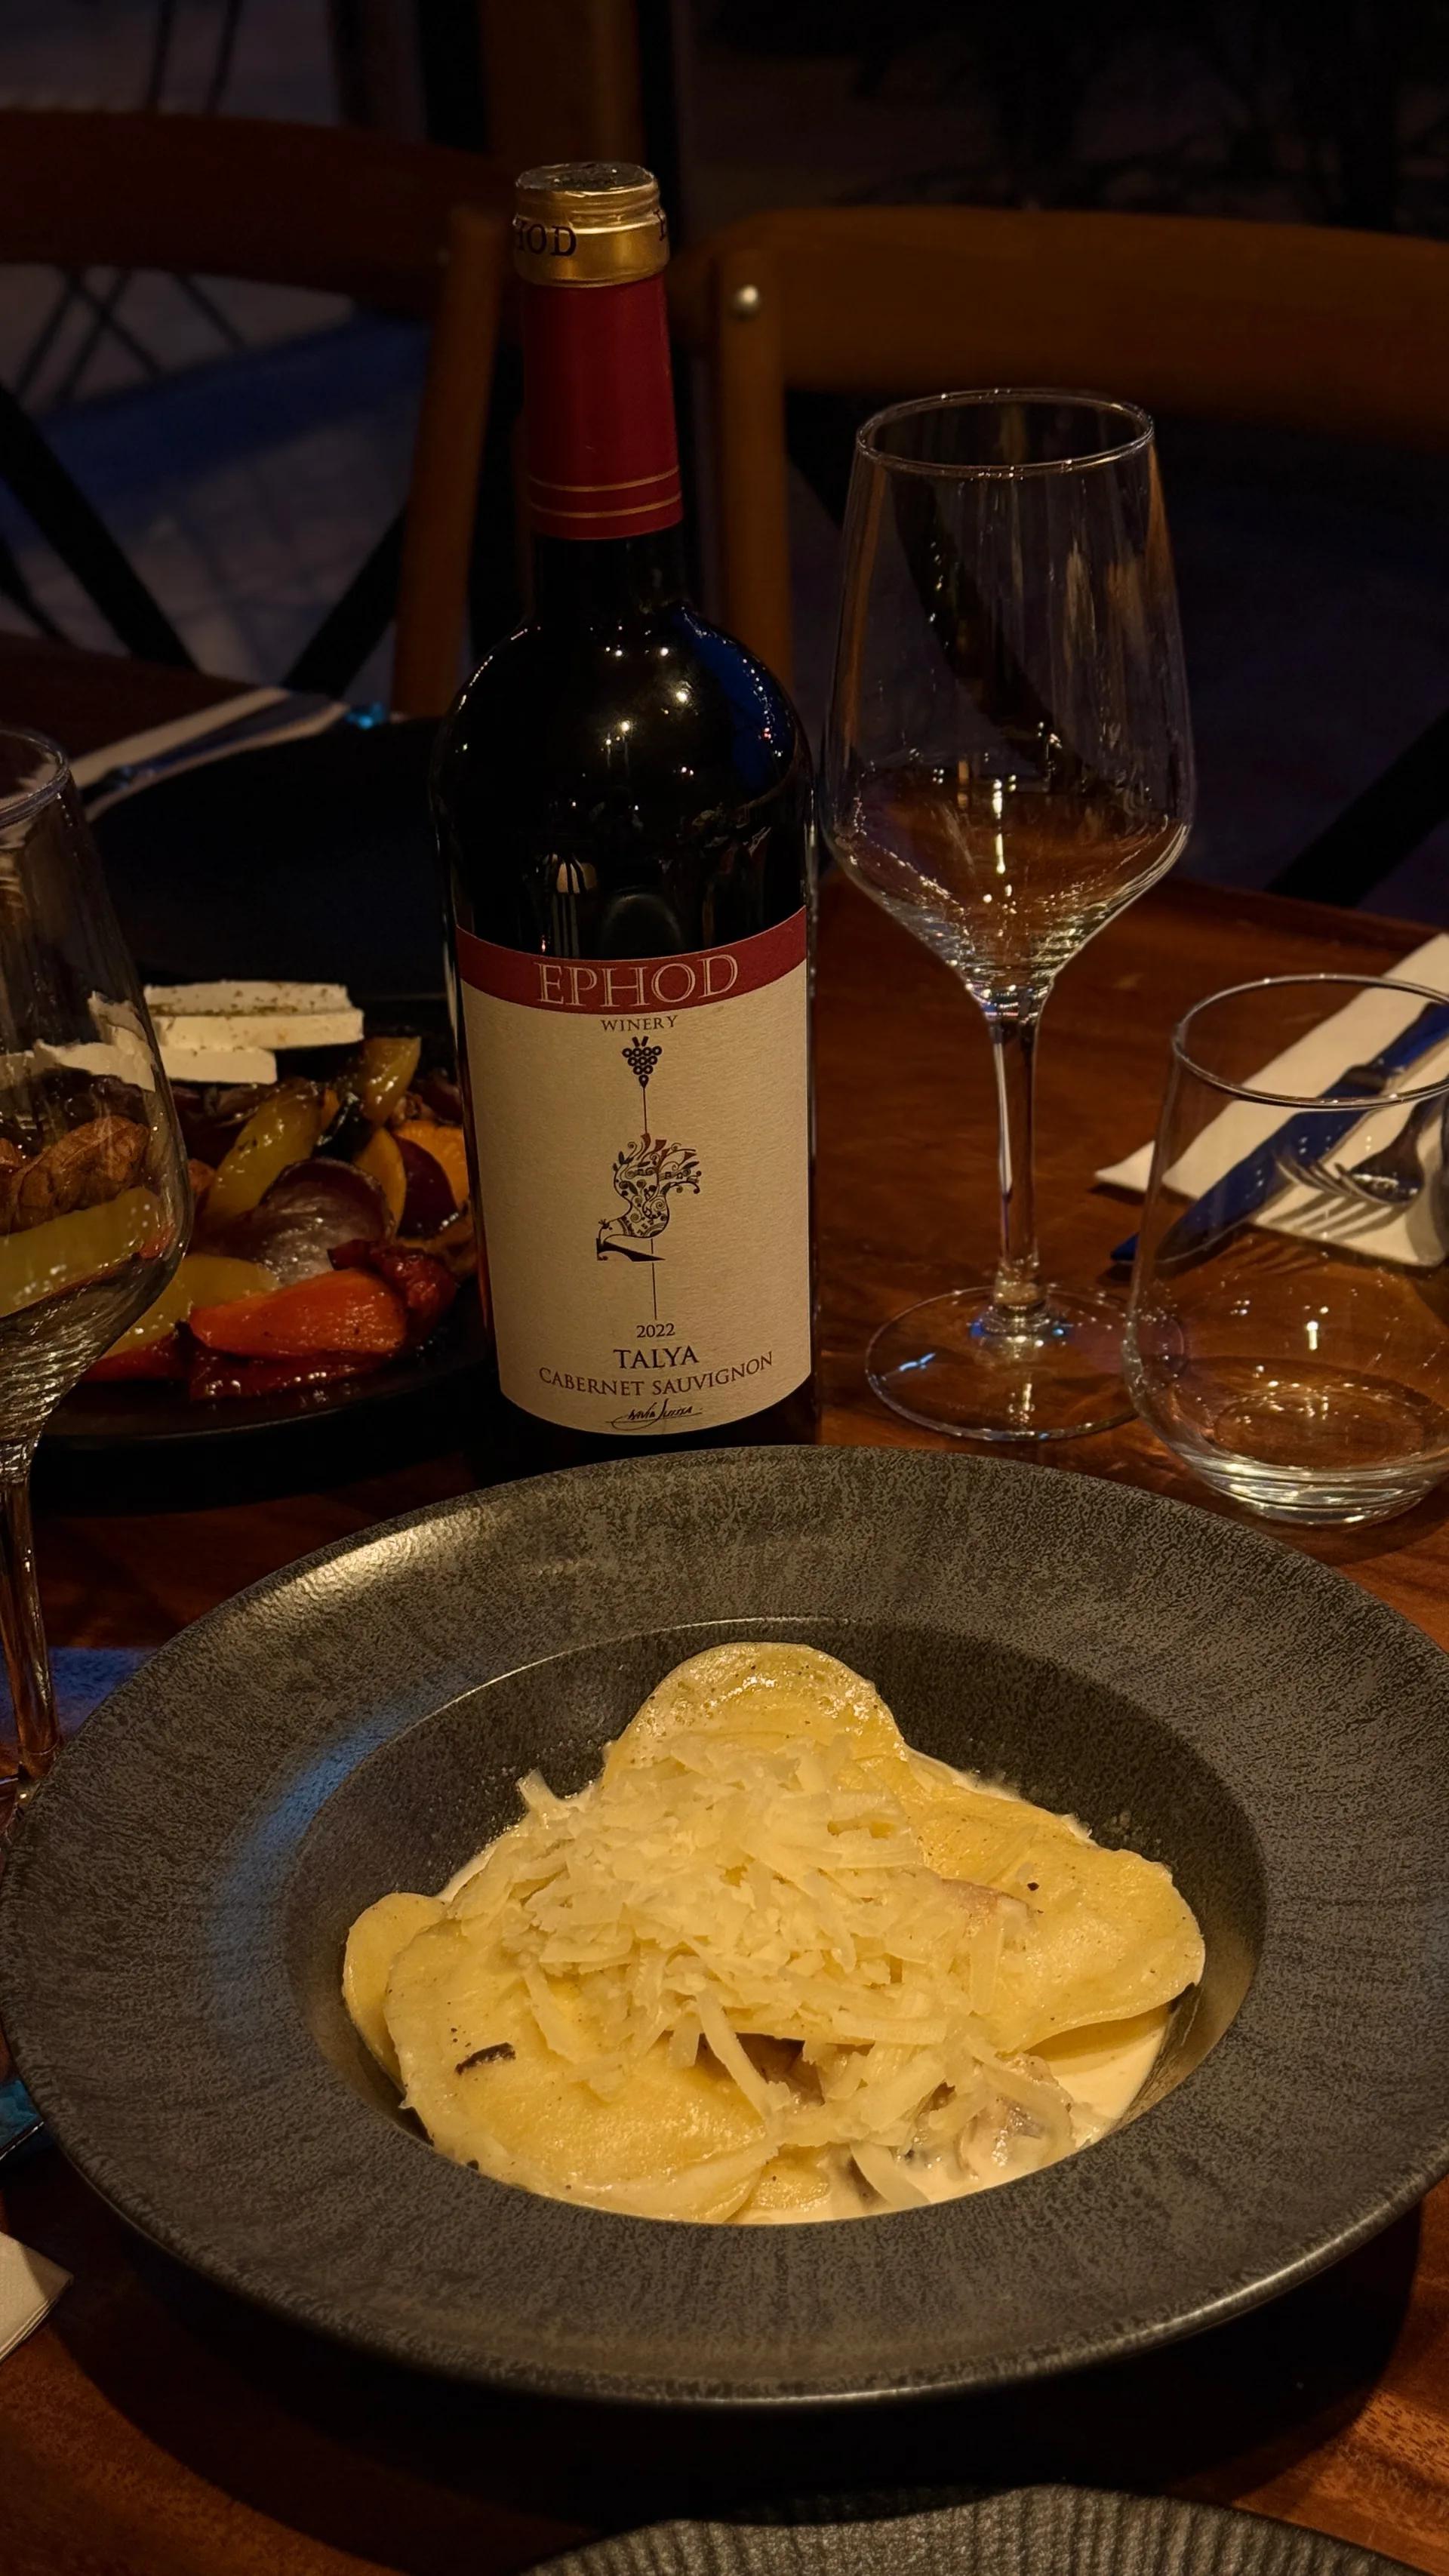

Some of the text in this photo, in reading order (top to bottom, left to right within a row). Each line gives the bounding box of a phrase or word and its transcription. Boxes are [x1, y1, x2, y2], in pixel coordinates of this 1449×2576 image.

[534, 954, 739, 1008] EPHOD
[601, 1014, 678, 1033] WINERY
[636, 1322, 675, 1338] 2022
[613, 1346, 700, 1369] TALYA
[539, 1351, 774, 1396] CABERNET SAUVIGNON
